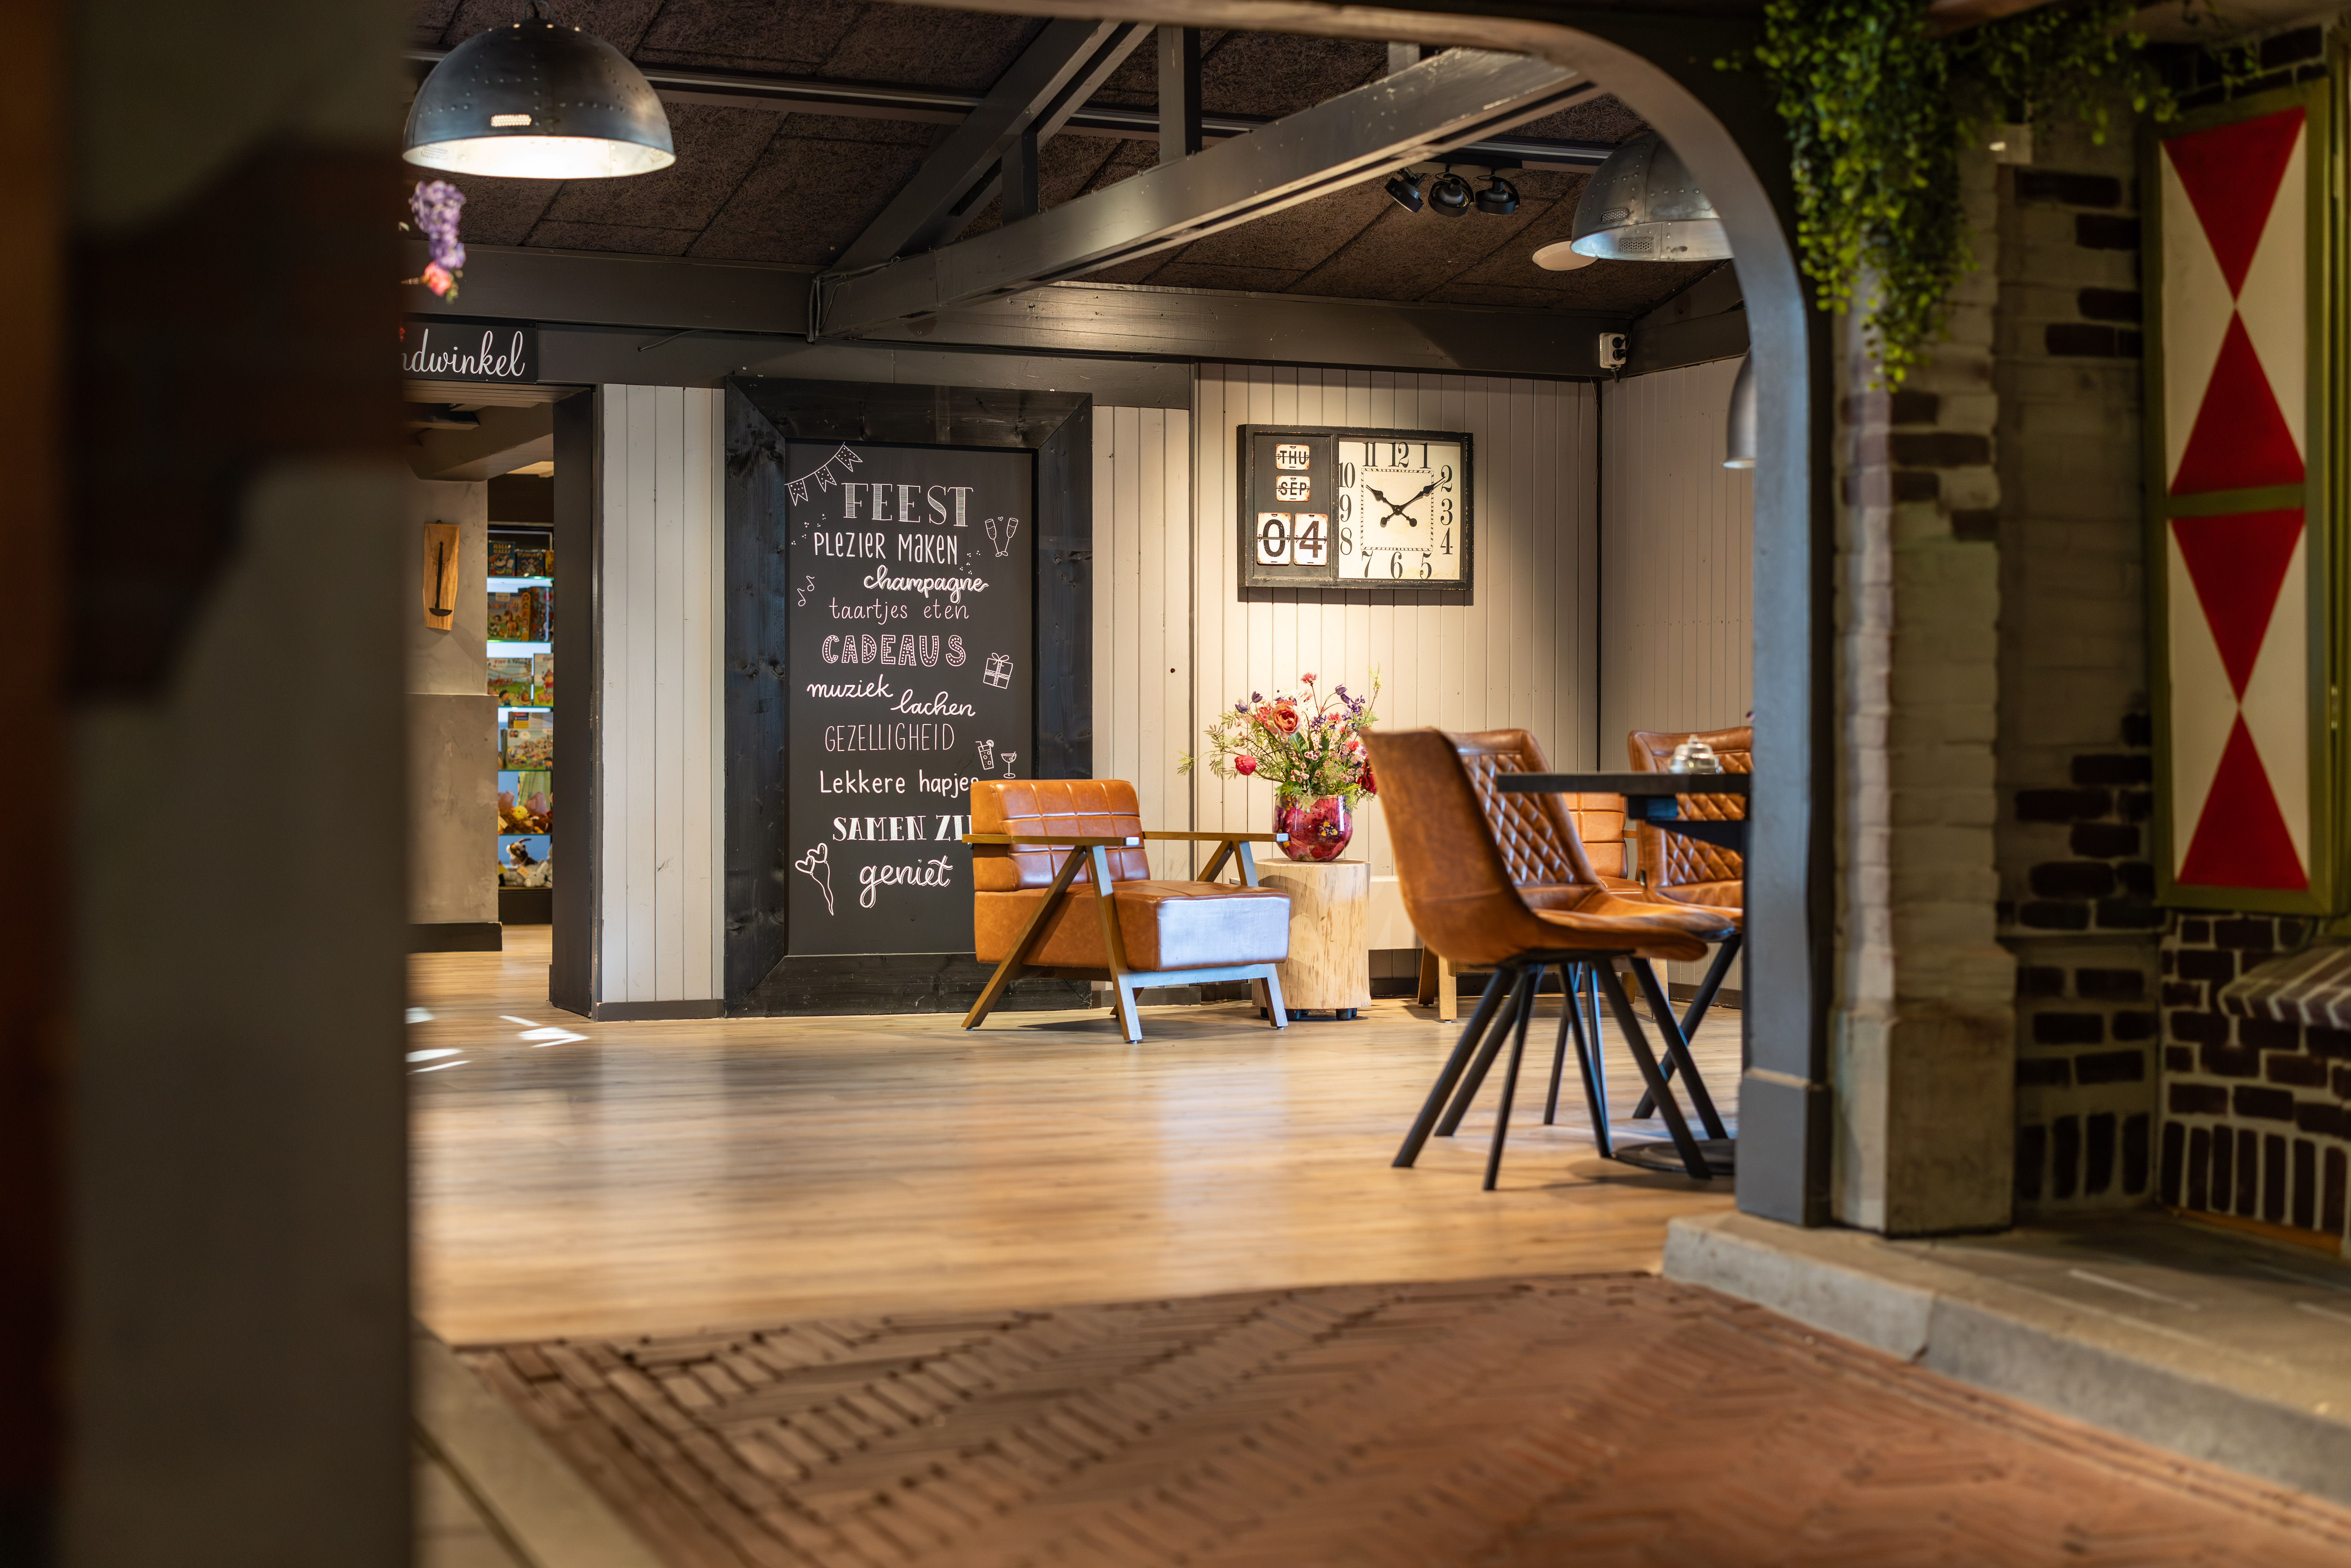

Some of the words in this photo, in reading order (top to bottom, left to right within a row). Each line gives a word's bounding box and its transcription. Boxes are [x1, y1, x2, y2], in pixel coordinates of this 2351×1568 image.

[1280, 450, 1307, 465] THU
[1362, 441, 1378, 467] 11
[1388, 441, 1410, 468] 12
[1420, 442, 1432, 469] 1
[1280, 481, 1307, 495] SEP
[1339, 462, 1355, 488] 10
[1441, 465, 1452, 493] 2
[841, 482, 974, 527] FEEST
[1339, 494, 1352, 522] 9
[1441, 498, 1453, 526] 3
[1340, 527, 1353, 555] 8
[1440, 527, 1453, 554] 4
[1362, 551, 1373, 578] 7
[1391, 551, 1403, 579] 6
[1419, 553, 1432, 579] 5
[863, 564, 989, 603] champagne
[829, 597, 908, 625] taartjes
[923, 599, 969, 619] eten
[822, 634, 966, 667] CADEAUS
[806, 674, 894, 698] muziek
[890, 689, 976, 717] lachen
[825, 723, 954, 752] GEZELLIGHEID
[820, 769, 905, 794] Lekkere
[833, 815, 927, 841] SAMEN
[859, 855, 953, 908] geniet
